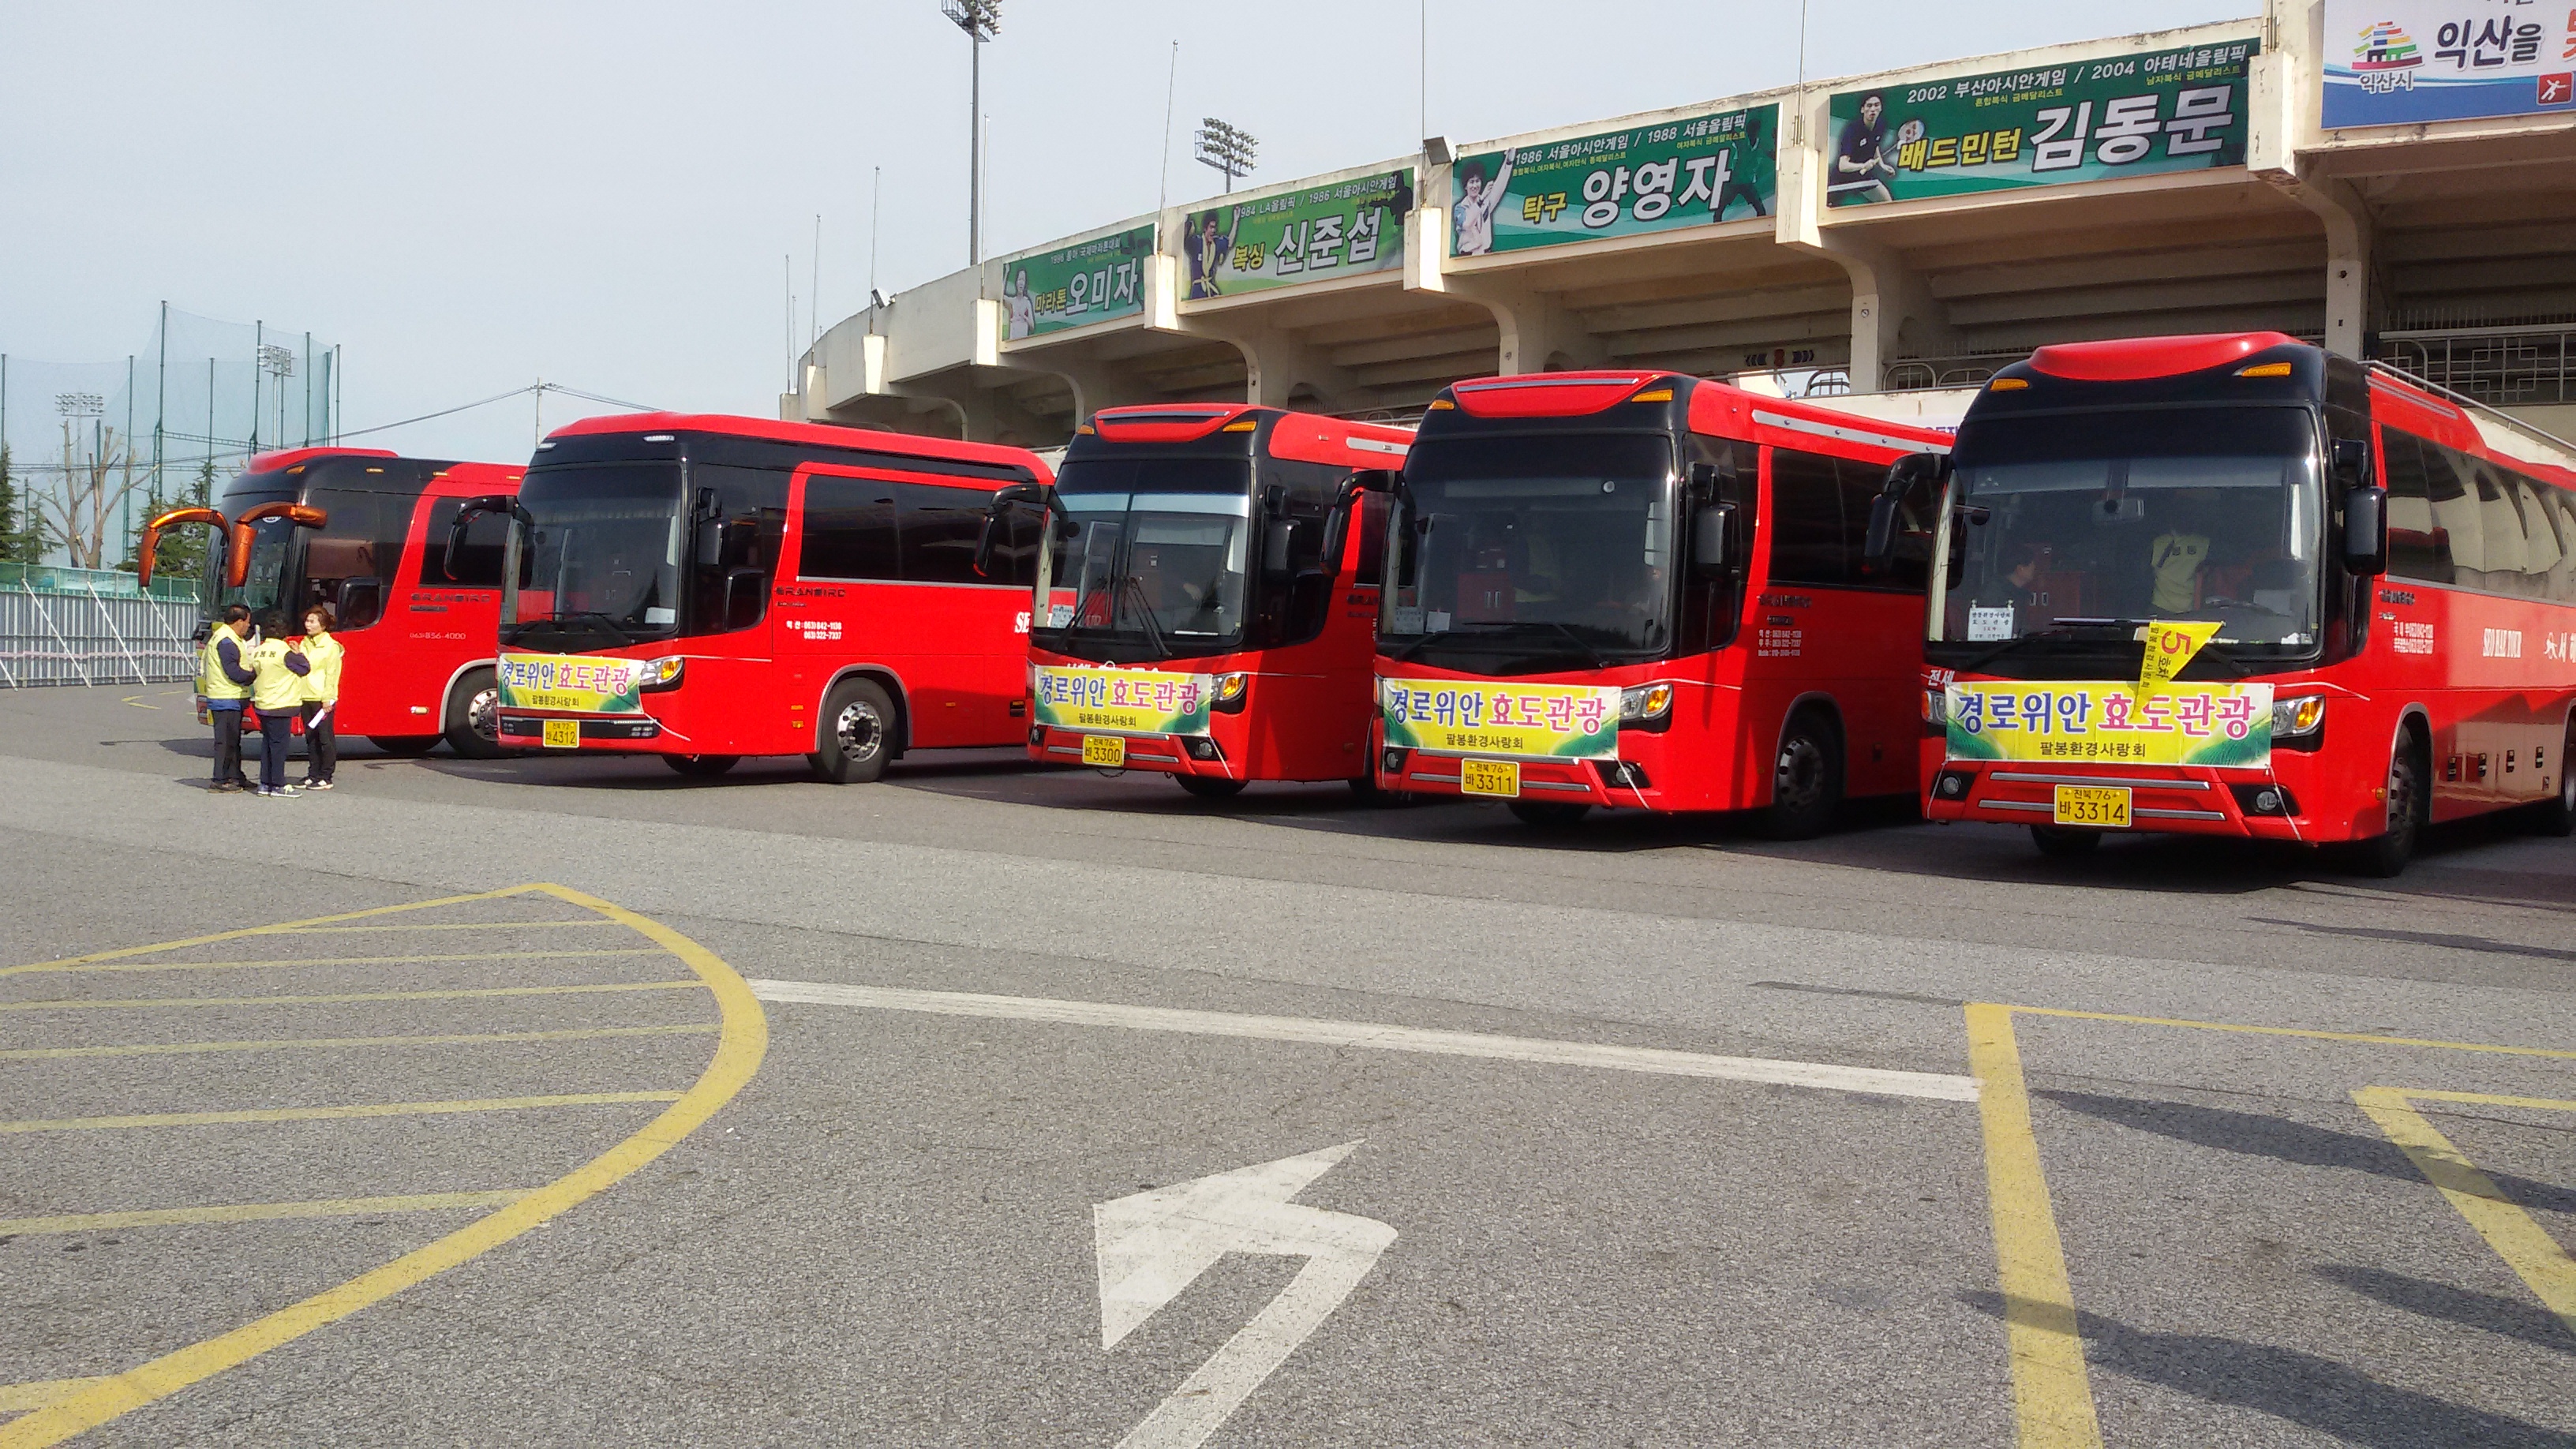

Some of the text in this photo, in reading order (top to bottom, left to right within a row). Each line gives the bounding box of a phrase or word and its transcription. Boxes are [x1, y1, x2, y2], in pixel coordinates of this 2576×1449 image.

[2434, 14, 2542, 69] 익산을
[1907, 43, 2248, 104] 2002 부산아시안게임 / 2004 아테네올림픽
[2358, 71, 2413, 92] 익산시
[1515, 149, 1542, 167] 1986
[1547, 134, 1630, 161] 서울아시안게임
[1647, 126, 1678, 144] 1988
[1683, 113, 1747, 138] 서울올림픽
[1897, 84, 2233, 174] 배드민턴 김동문
[1259, 197, 1296, 215] LA올림픽
[1309, 189, 1331, 205] 1986
[1334, 174, 1398, 200] 서울아시안게임
[1522, 148, 1733, 230] 탁구 양영자
[1233, 206, 1383, 276] 복싱 신준섭
[1035, 256, 1138, 316] 마라톤 오미자
[1014, 611, 1032, 634] SE
[2161, 630, 2192, 655] 5
[501, 661, 631, 696] 경로위안 효도관광
[1927, 669, 1956, 688] 전세
[2155, 656, 2171, 679] 호차
[1039, 676, 1201, 715] 경로위안 효도관광
[1079, 713, 1137, 727] 팔봉환경사랑회
[1390, 689, 1606, 736] 경로위안 효도관광
[1957, 691, 2257, 740] 경로위안 효도관광
[552, 731, 576, 744] 4312
[1446, 732, 1524, 750] 팔봉환경사랑회
[2040, 741, 2147, 758] 팔봉환경사랑회
[1093, 747, 1121, 762] 3300
[1491, 764, 1503, 773] 76
[1465, 773, 1511, 792] 바 3311
[2073, 789, 2111, 800] 전북 76
[2059, 800, 2125, 822] 바 3314
